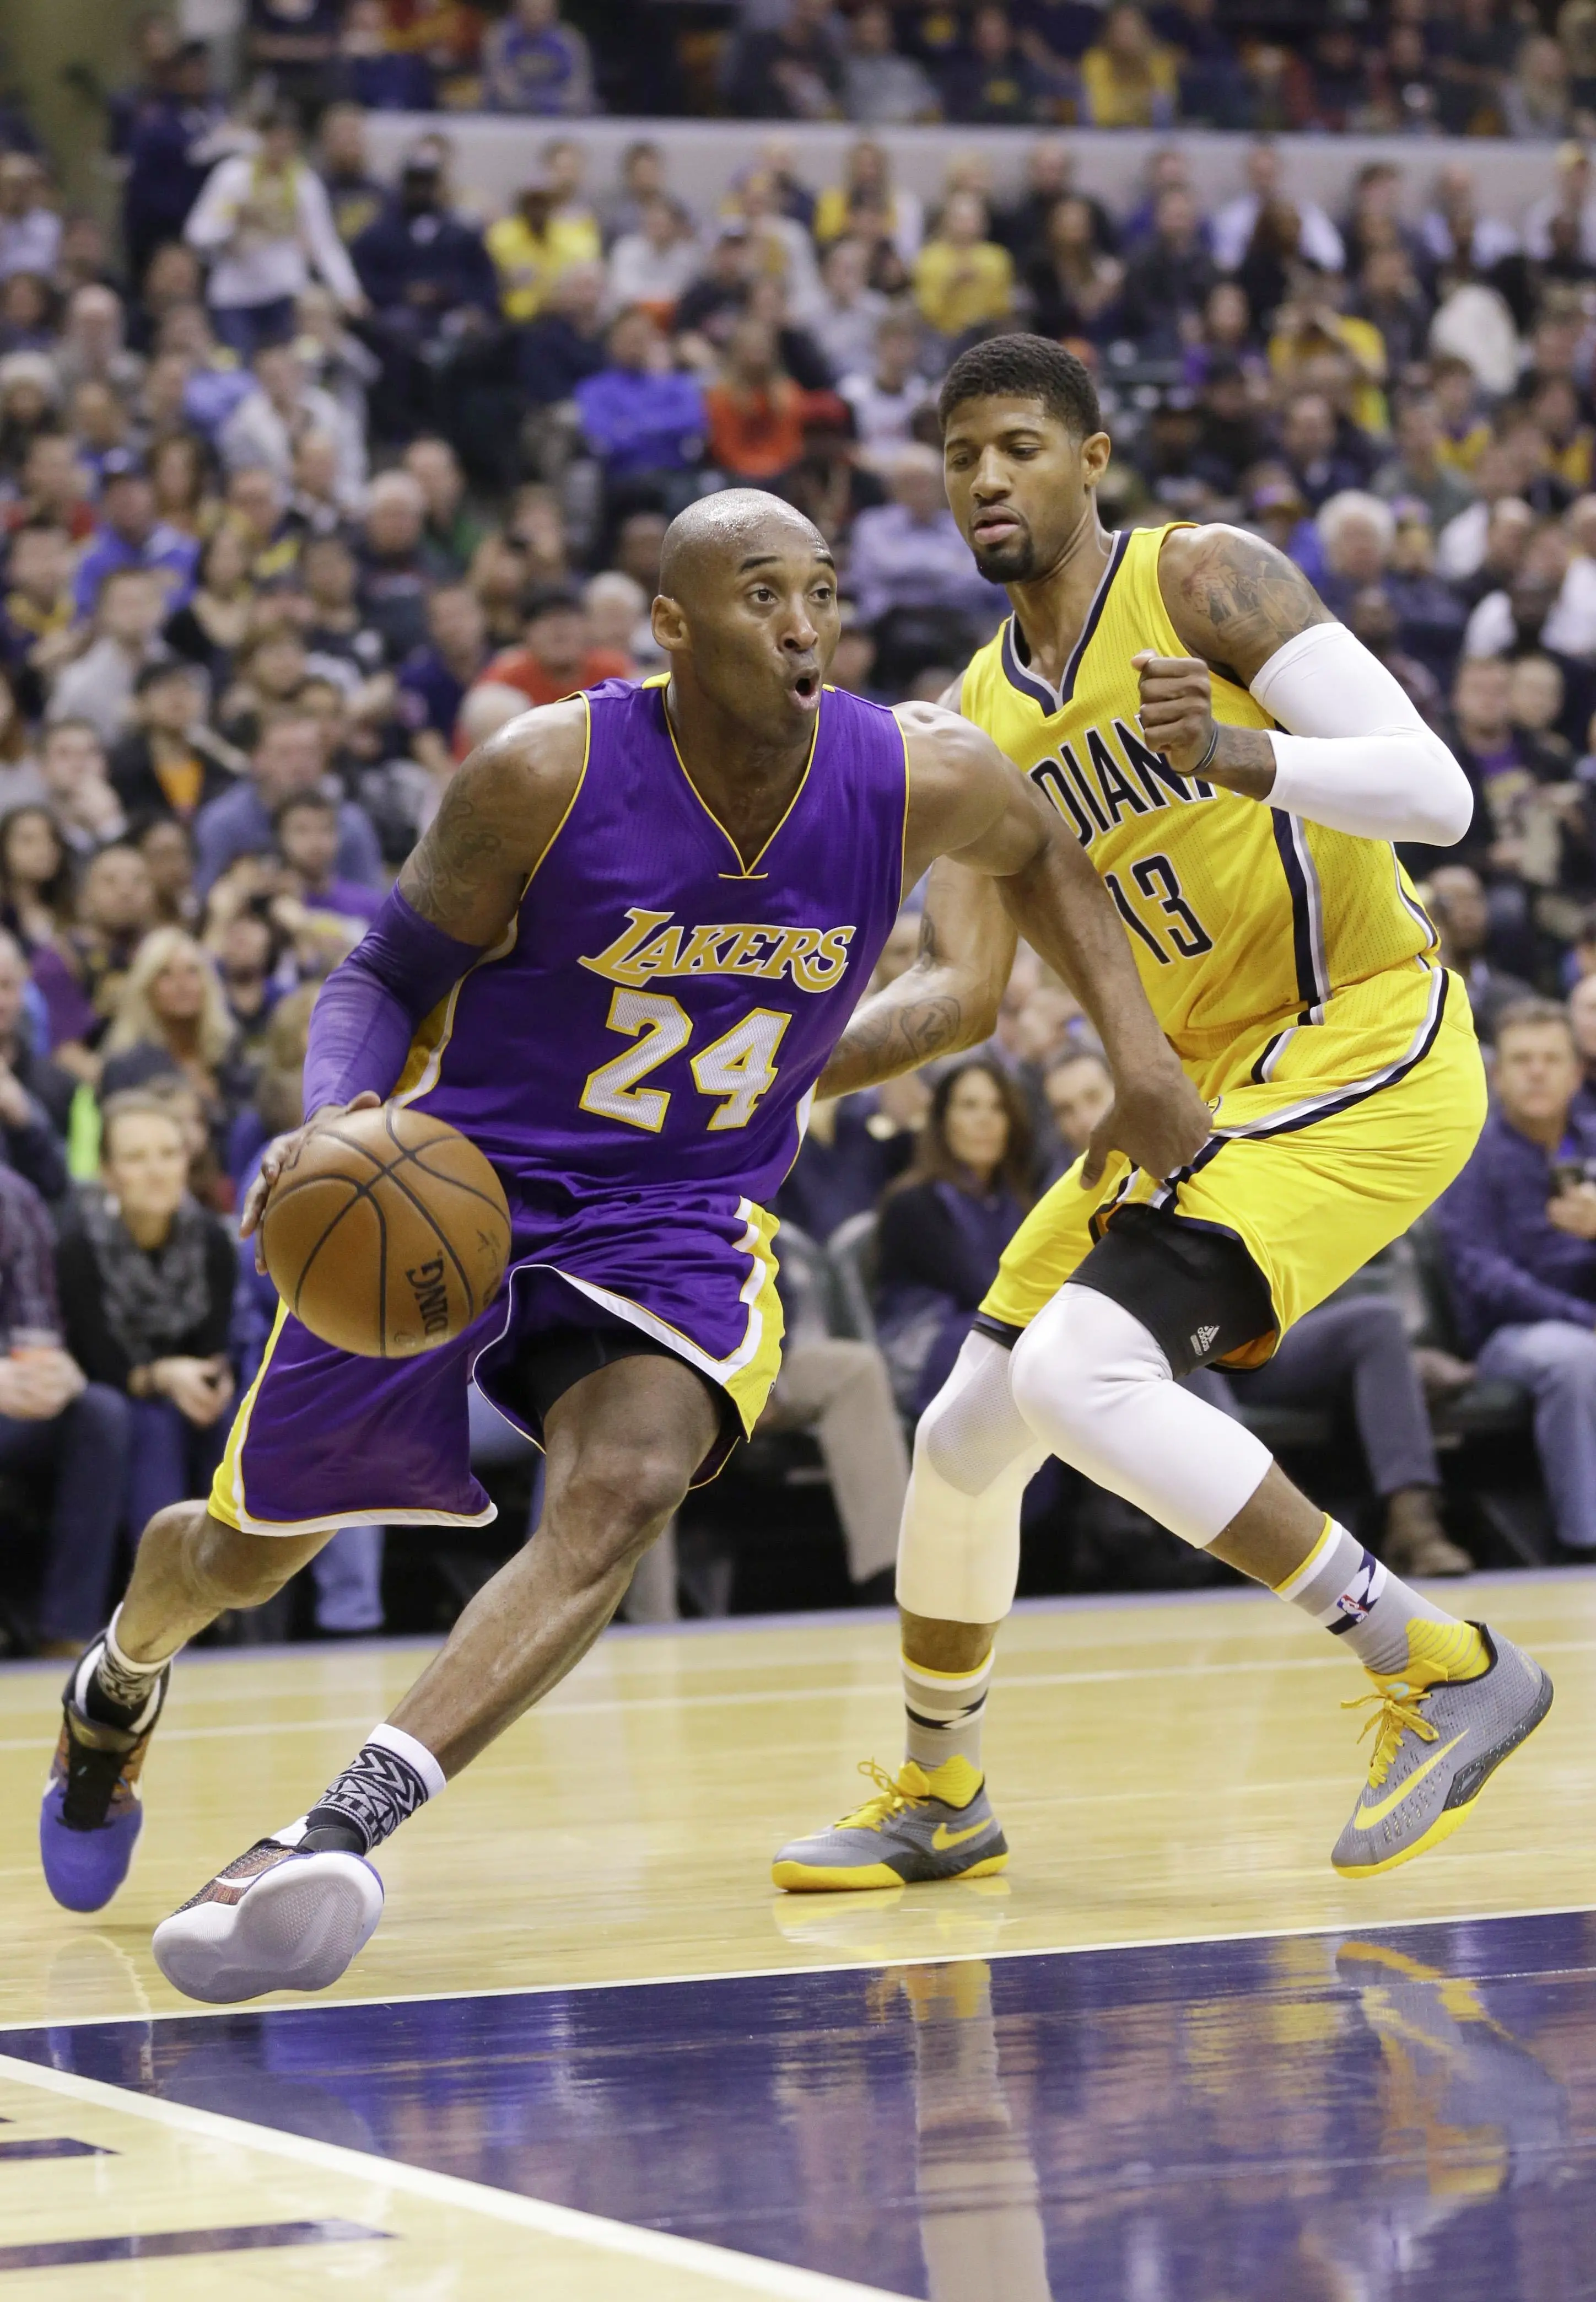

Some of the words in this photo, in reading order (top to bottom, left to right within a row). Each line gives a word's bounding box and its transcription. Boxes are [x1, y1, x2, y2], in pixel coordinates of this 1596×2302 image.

[1027, 714, 1243, 849] DIAN
[577, 907, 856, 993] LAKERS
[1105, 852, 1214, 966] 13
[579, 987, 792, 1133] 24
